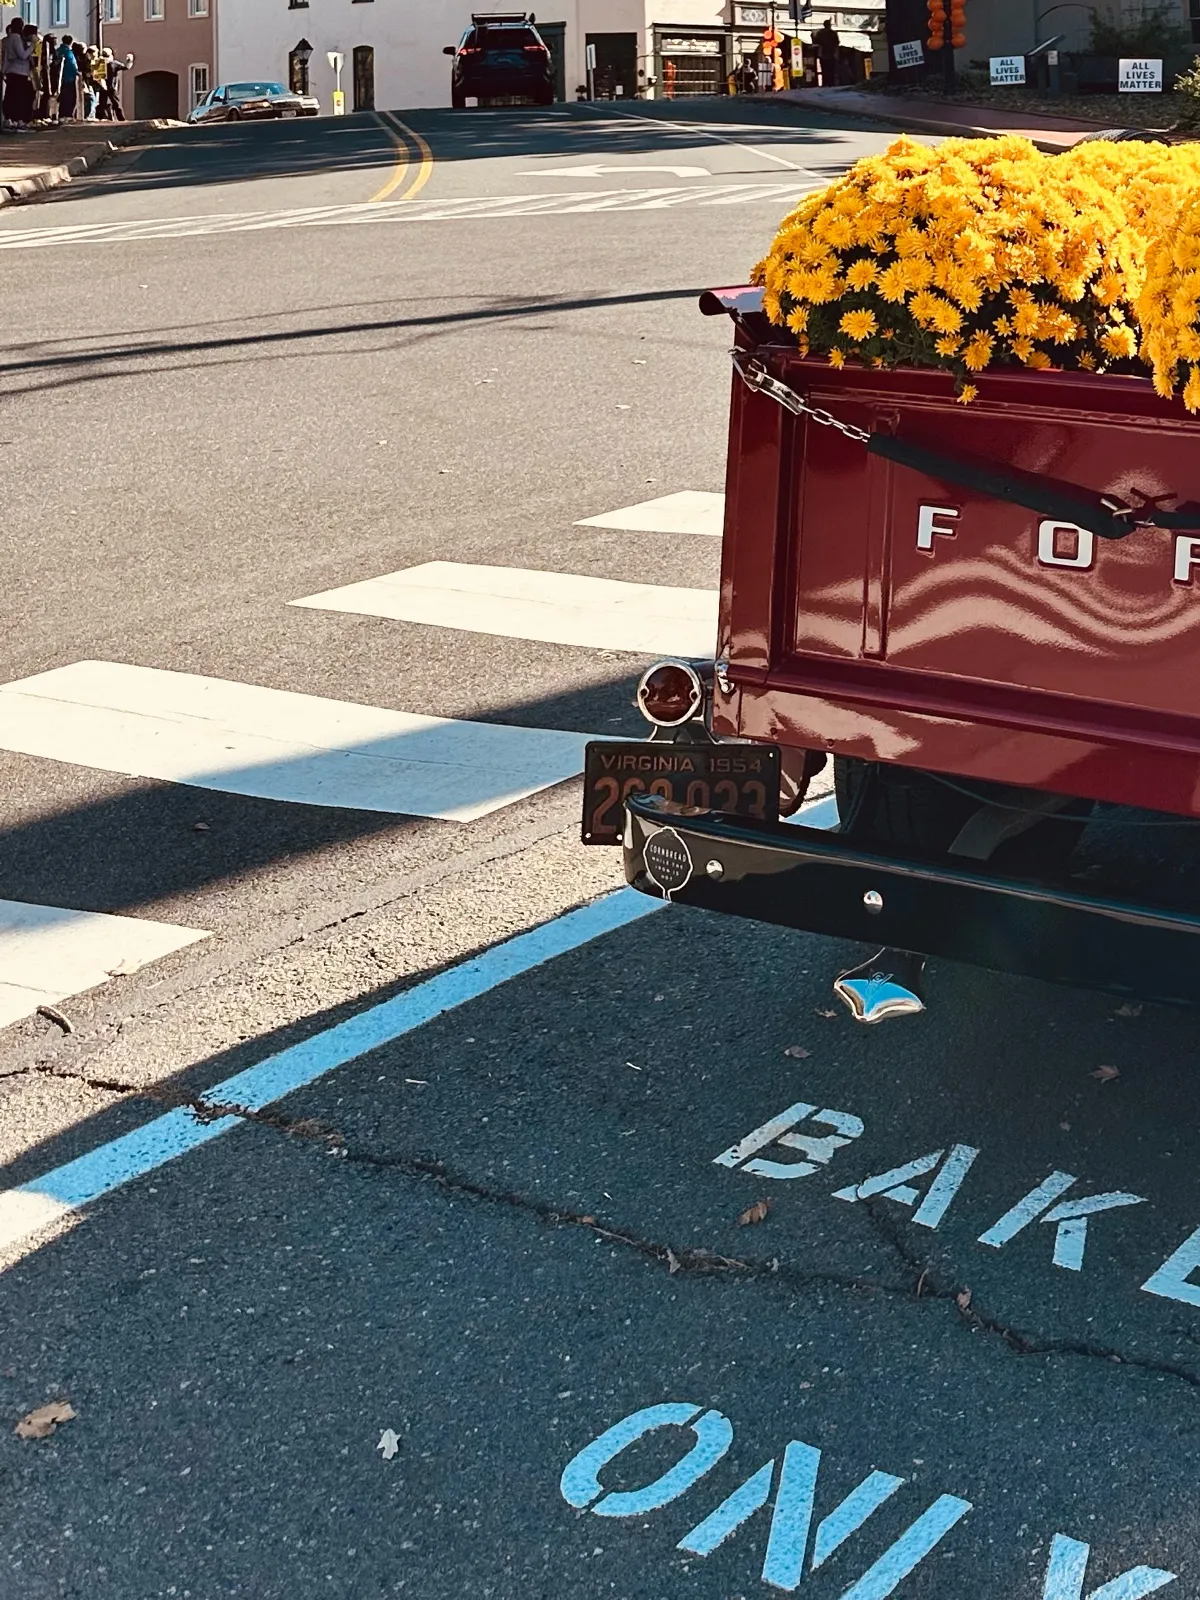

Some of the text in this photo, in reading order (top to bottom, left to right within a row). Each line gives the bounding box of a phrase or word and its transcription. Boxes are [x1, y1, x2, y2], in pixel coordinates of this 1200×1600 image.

[899, 50, 918, 59] LIVES
[1132, 62, 1150, 70] ALL
[991, 74, 1025, 82] MATTER
[1126, 71, 1155, 80] LIVES
[1120, 80, 1161, 89] MATTER
[601, 754, 762, 773] VIRGINIA 1954
[650, 844, 687, 862] CORNBREAD
